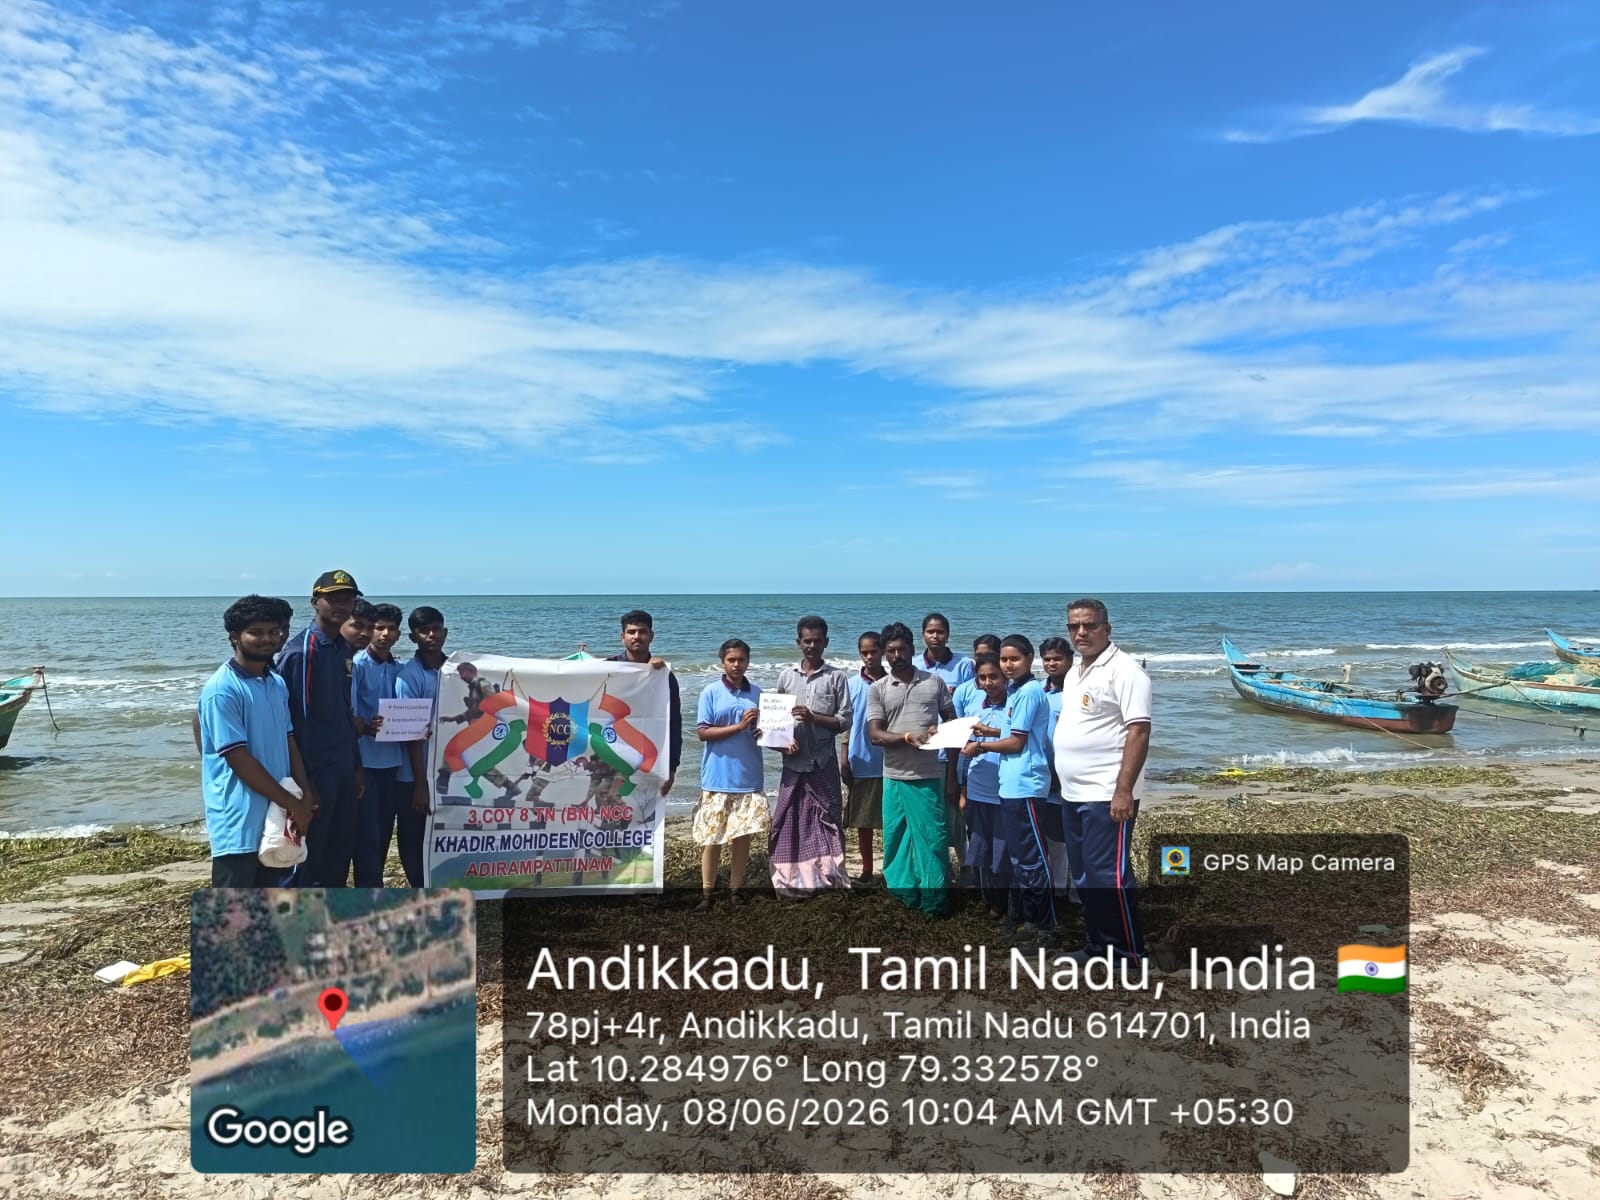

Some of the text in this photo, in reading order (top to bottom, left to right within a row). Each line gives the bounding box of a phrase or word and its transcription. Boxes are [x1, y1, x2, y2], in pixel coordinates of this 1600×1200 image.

[550, 724, 571, 736] NCC
[520, 807, 529, 822] 8
[535, 807, 556, 823] TN
[561, 807, 595, 824] (BN)
[600, 806, 633, 822] NCC
[434, 830, 653, 853] KHADIR MOHIDEEN COLLEGE
[466, 856, 613, 877] ADIRAMPATTINAM
